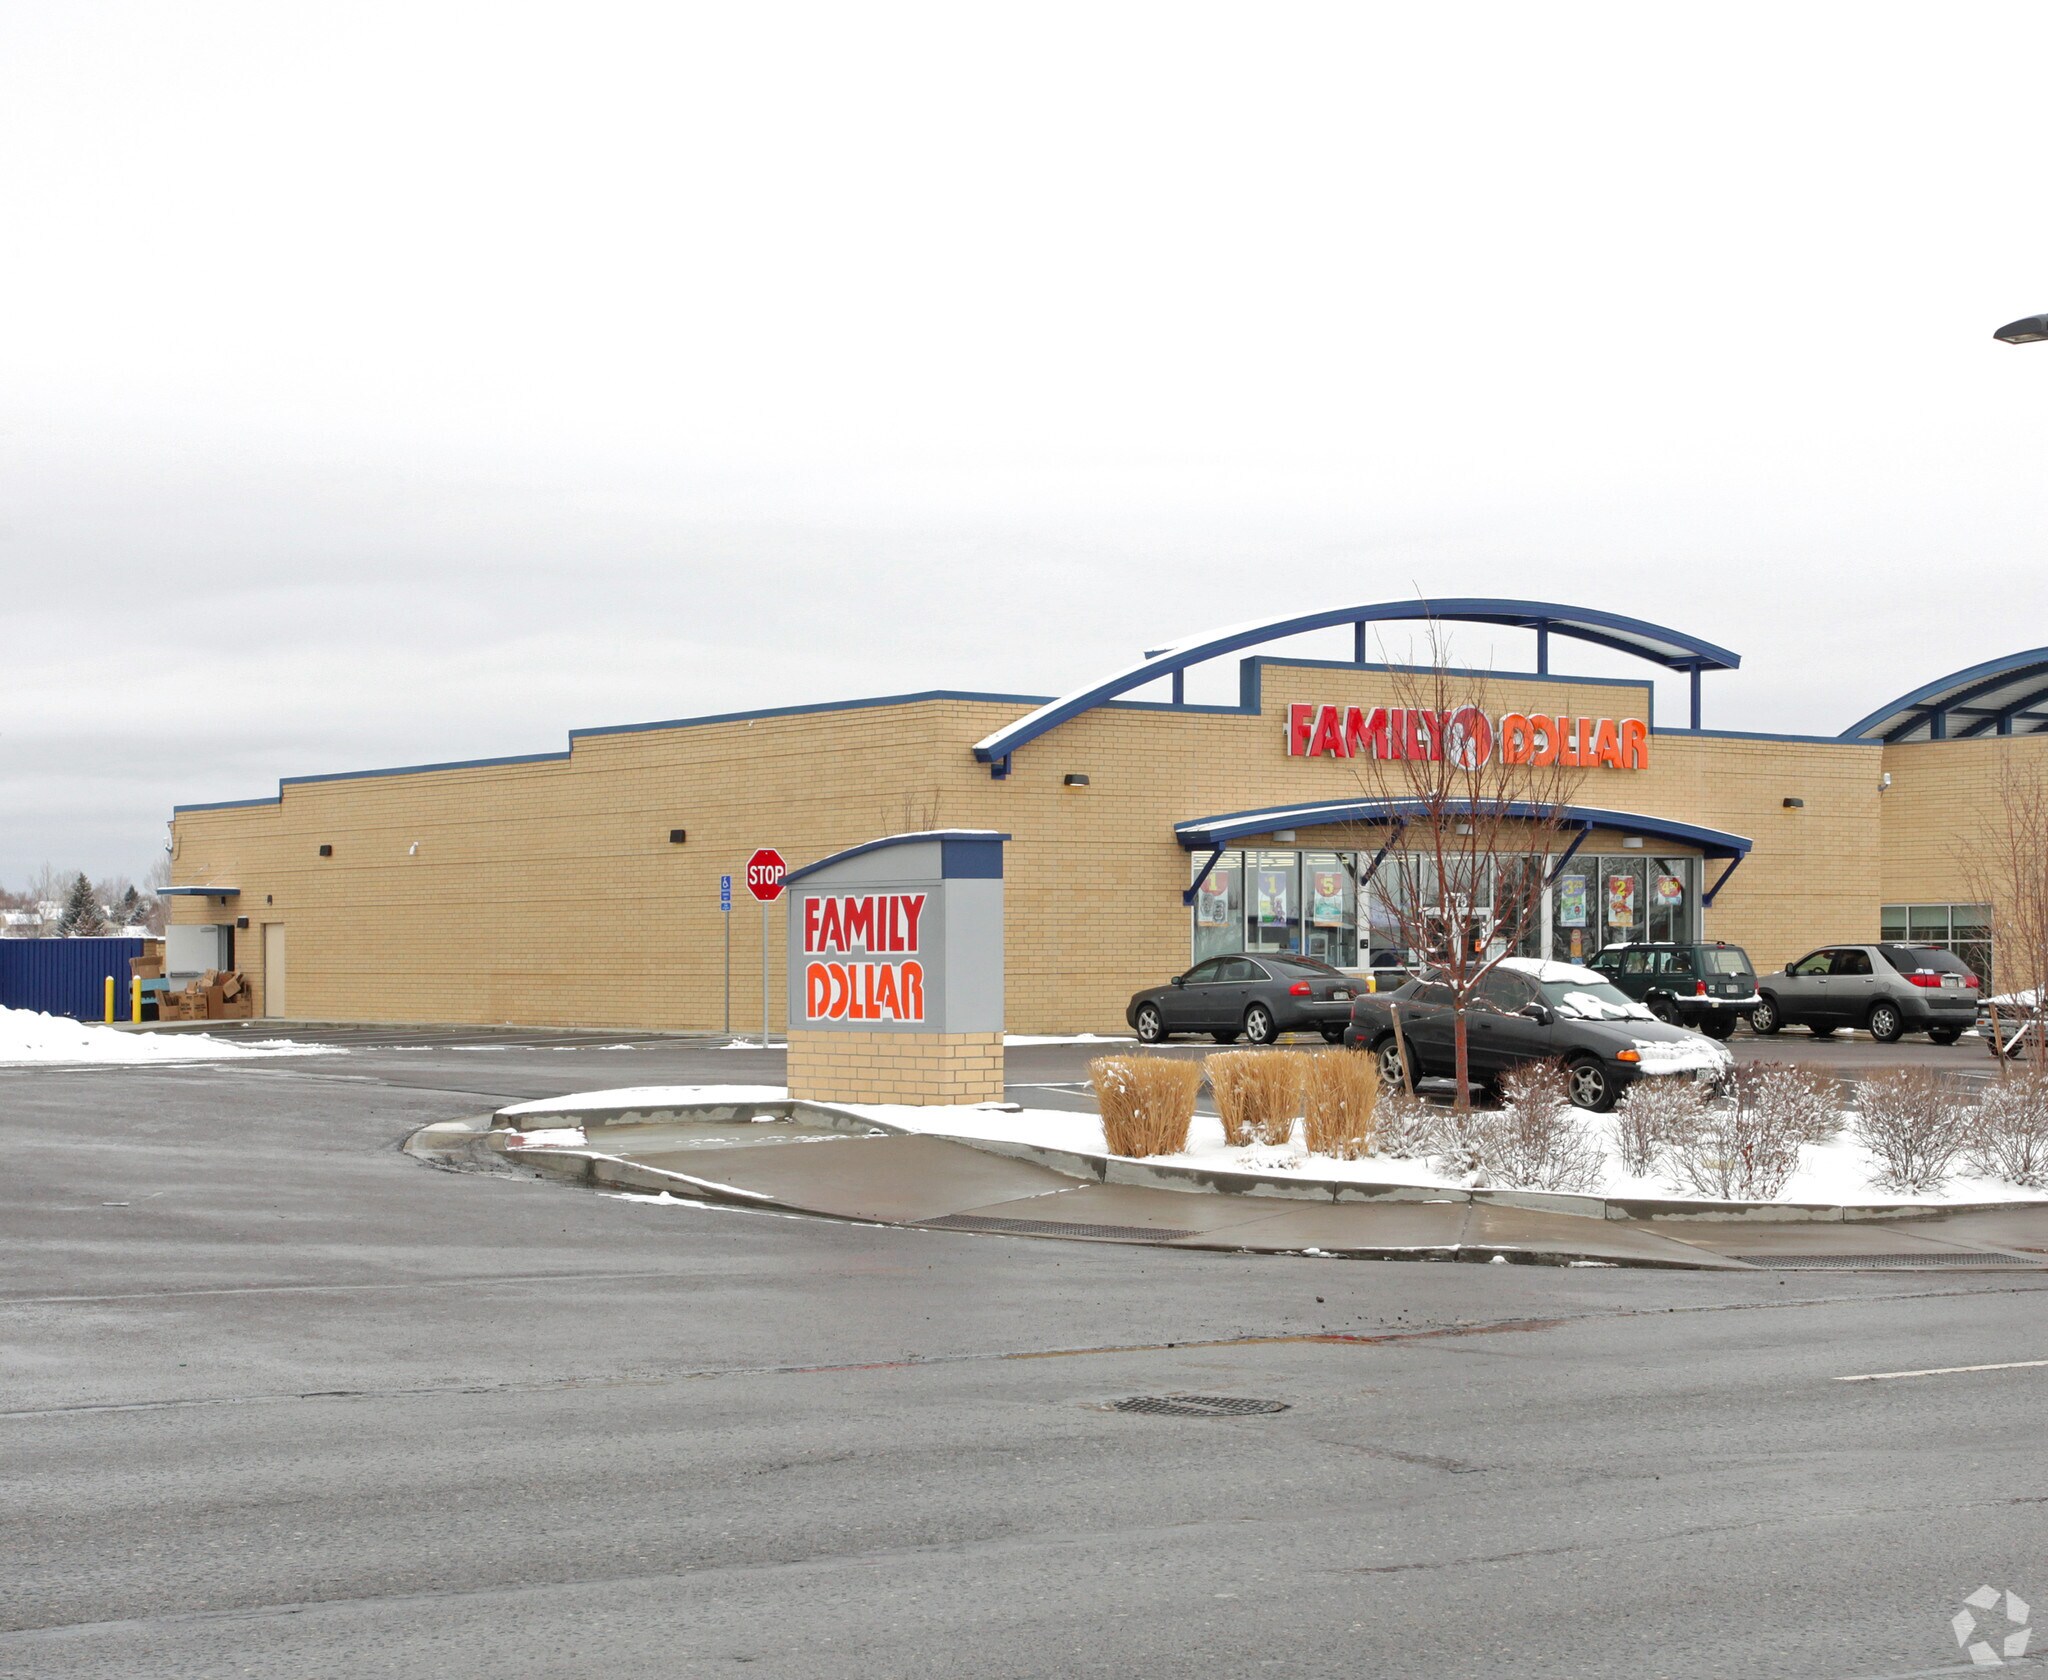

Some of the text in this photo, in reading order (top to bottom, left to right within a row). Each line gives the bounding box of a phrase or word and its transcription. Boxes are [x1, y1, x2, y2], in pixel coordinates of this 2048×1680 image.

[1287, 702, 1648, 770] FAMILY DOLLAR
[749, 865, 784, 885] STOP
[804, 893, 927, 953] FAMILY
[805, 961, 924, 1022] DOLLAR
